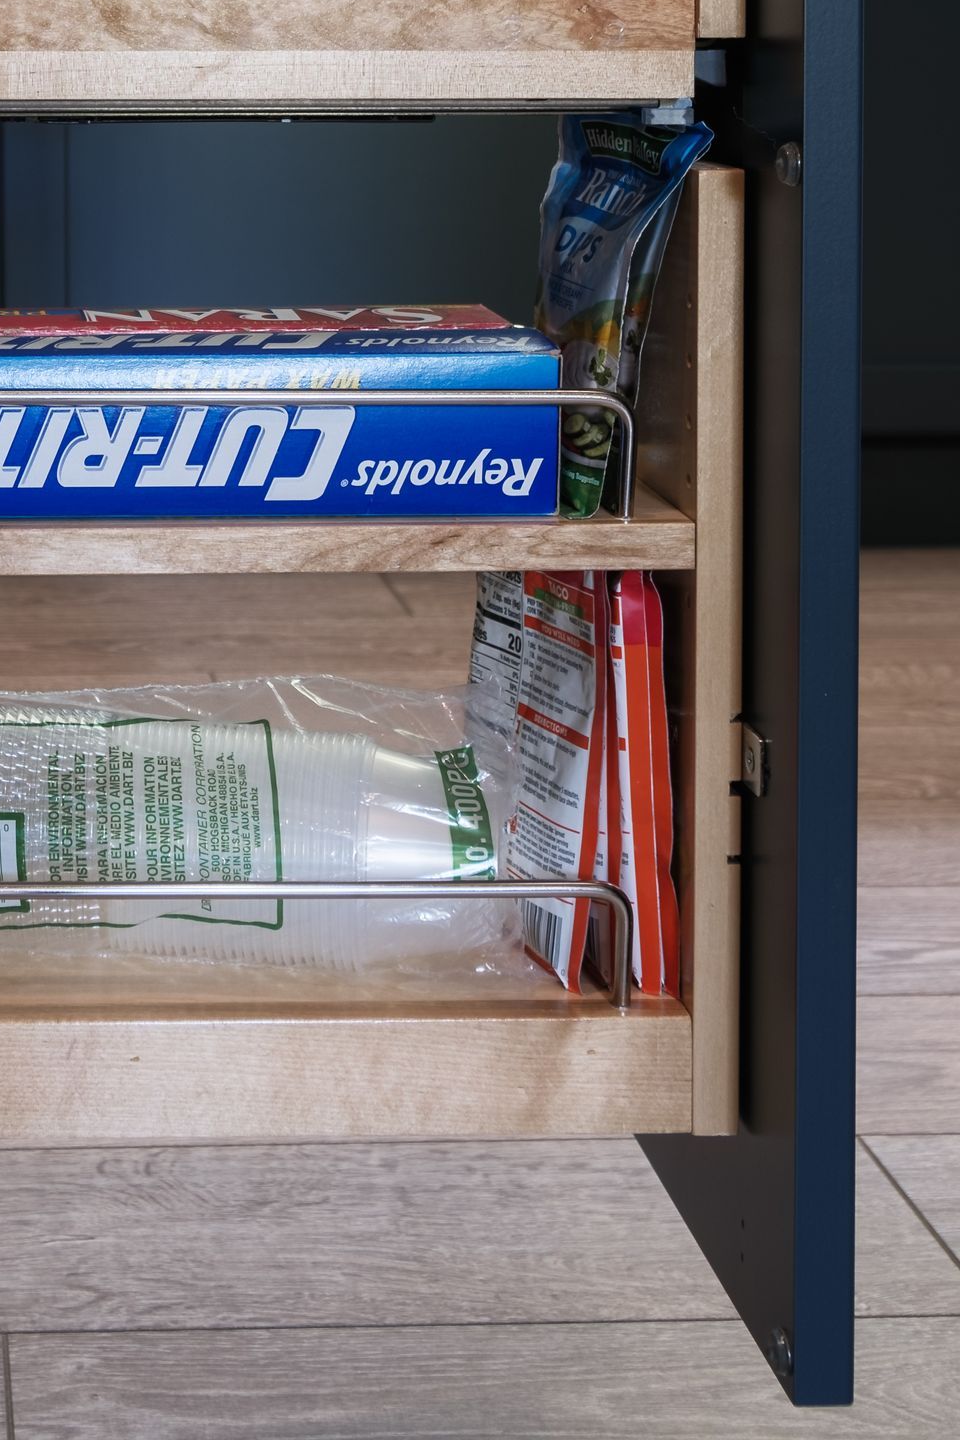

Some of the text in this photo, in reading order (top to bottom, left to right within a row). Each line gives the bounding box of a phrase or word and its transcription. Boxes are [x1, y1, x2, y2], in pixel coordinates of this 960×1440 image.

[343, 334, 532, 350] Reynolds
[350, 448, 544, 498] Reynolds
[507, 632, 521, 654] 20
[48, 750, 60, 861] ENVIRONMENTAL
[74, 753, 87, 858] WWW.DART.BIZ
[108, 744, 122, 855] EL MEDIO AMBIENTE
[122, 750, 136, 848] WWW.DART.BIZ
[143, 756, 157, 845] INFORMATION
[209, 795, 219, 852] HOGSBACK
[218, 802, 229, 853] MICHIGAN
[229, 785, 238, 818] HECHO
[250, 787, 261, 848] www.dart.biz
